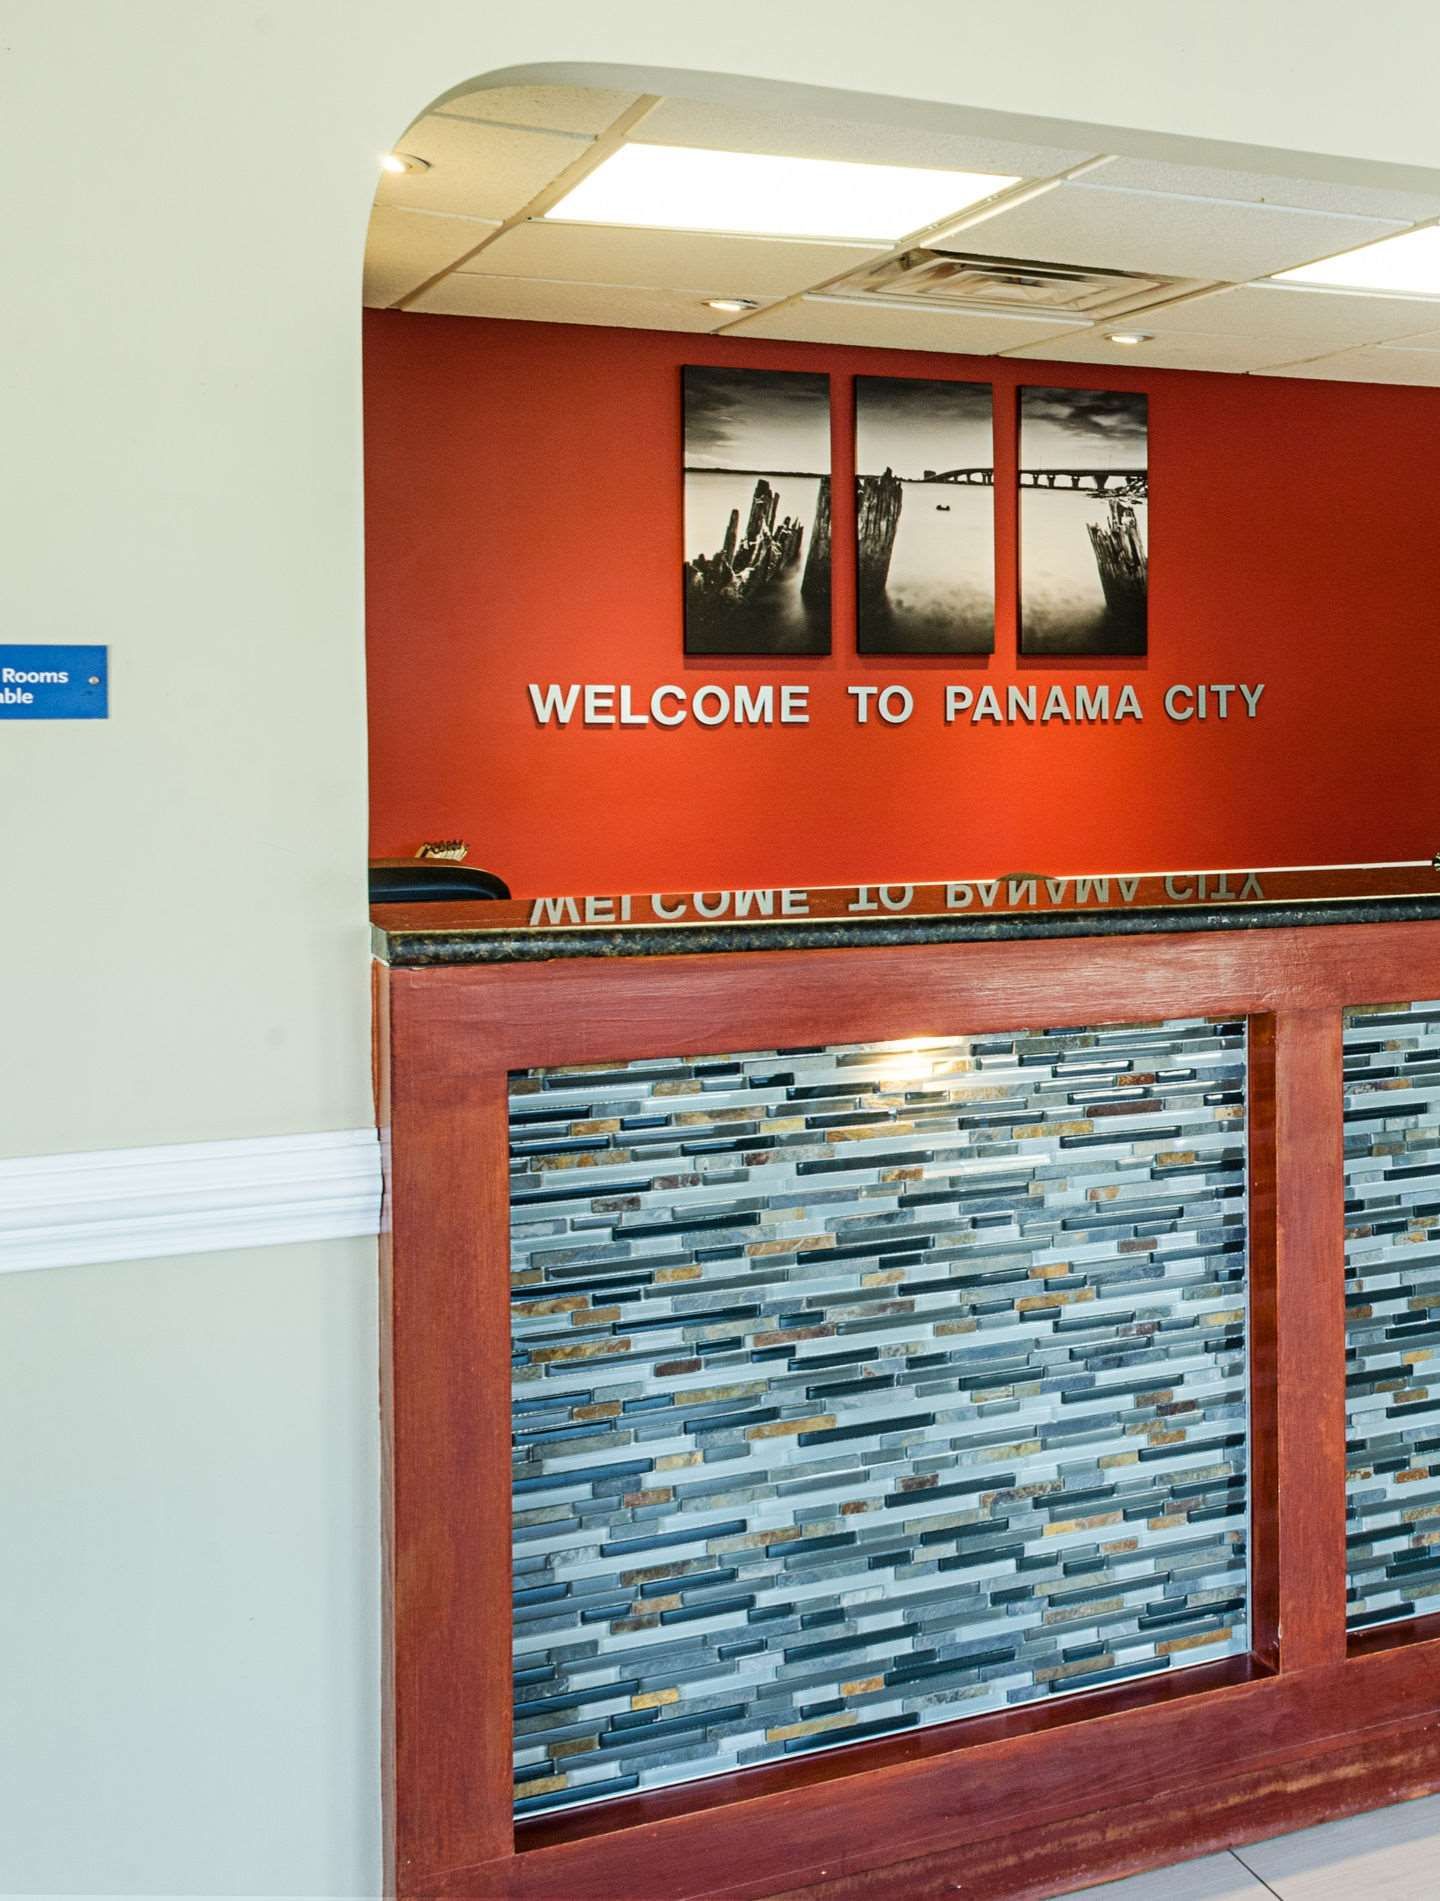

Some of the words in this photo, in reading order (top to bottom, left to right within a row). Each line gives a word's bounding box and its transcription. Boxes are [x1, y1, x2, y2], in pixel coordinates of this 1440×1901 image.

[2, 667, 69, 684] Rooms
[528, 684, 810, 726] WELCOME
[848, 685, 914, 724] TO
[945, 684, 1144, 722] PANAMA
[1164, 683, 1265, 720] CITY
